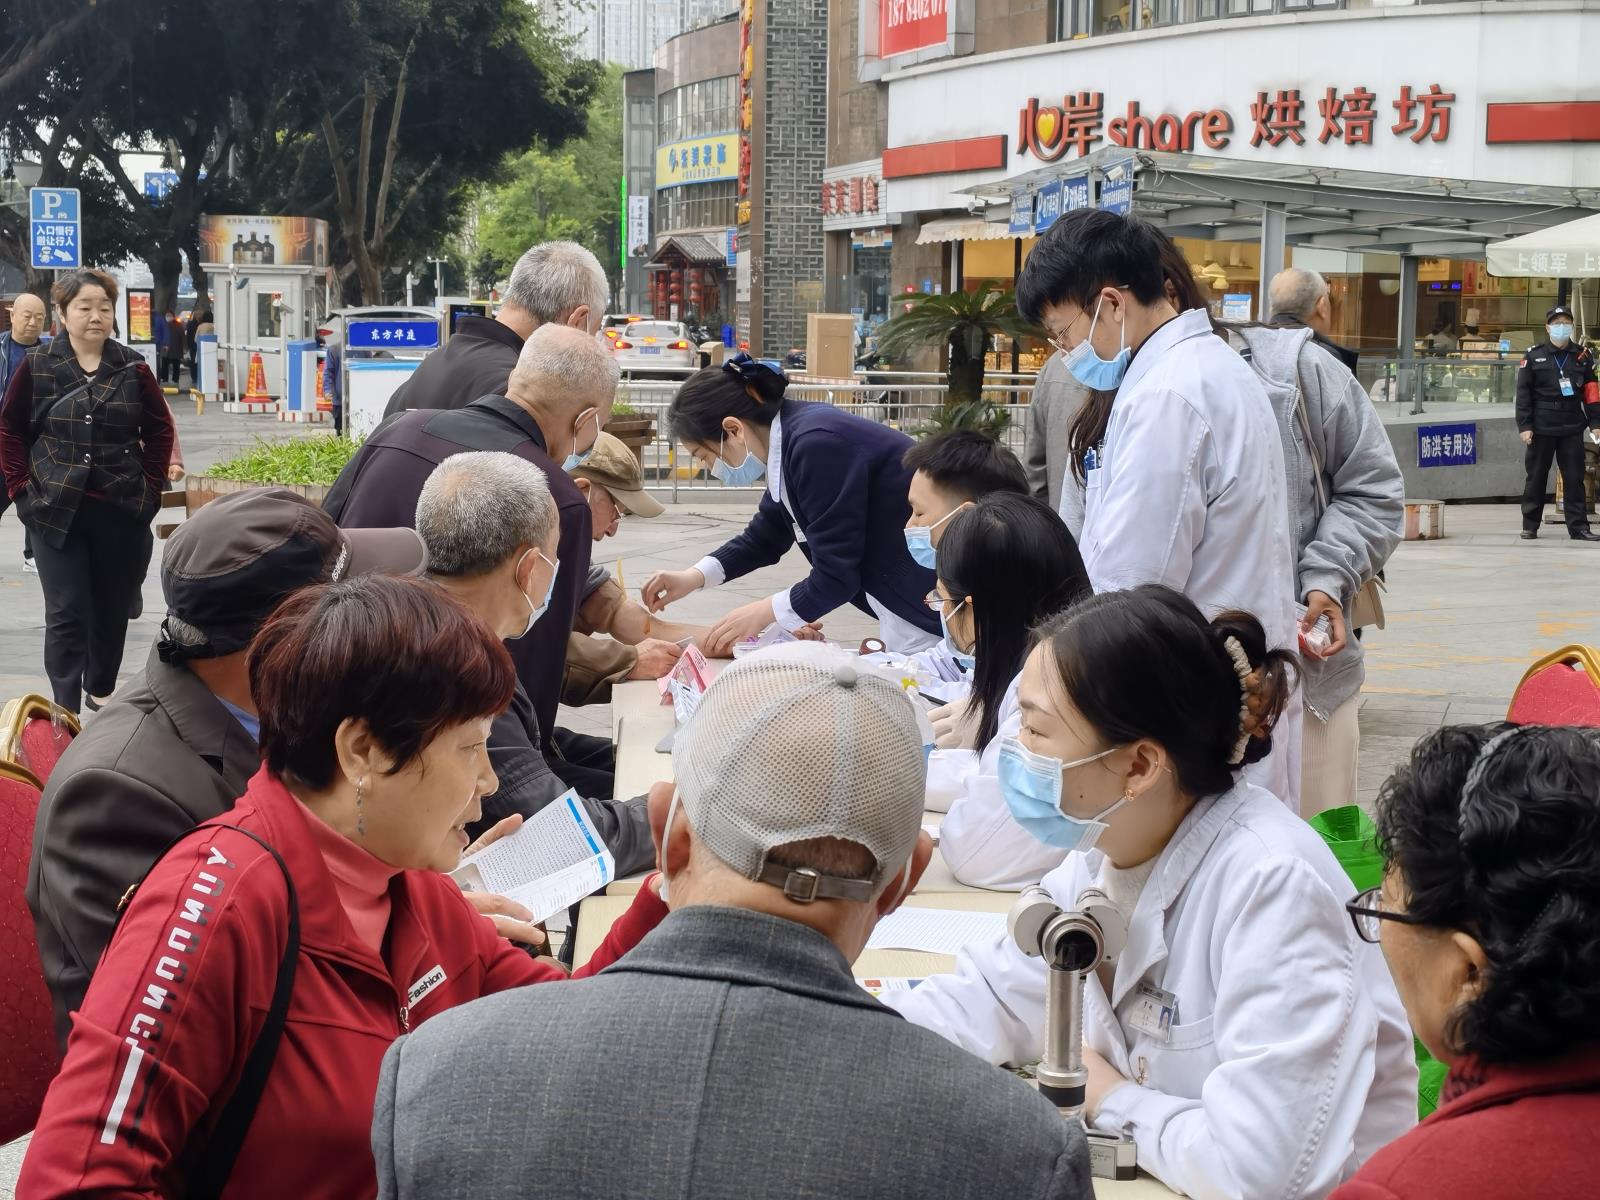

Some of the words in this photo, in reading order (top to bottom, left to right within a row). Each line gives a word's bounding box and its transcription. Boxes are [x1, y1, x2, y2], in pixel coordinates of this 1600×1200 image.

[1107, 100, 1234, 154] share
[1250, 83, 1457, 149] 烘焙坊
[41, 192, 62, 219] P
[1578, 252, 1600, 273] 上
[1421, 433, 1474, 459] 防洪专用沙
[408, 971, 443, 1004] Fashion
